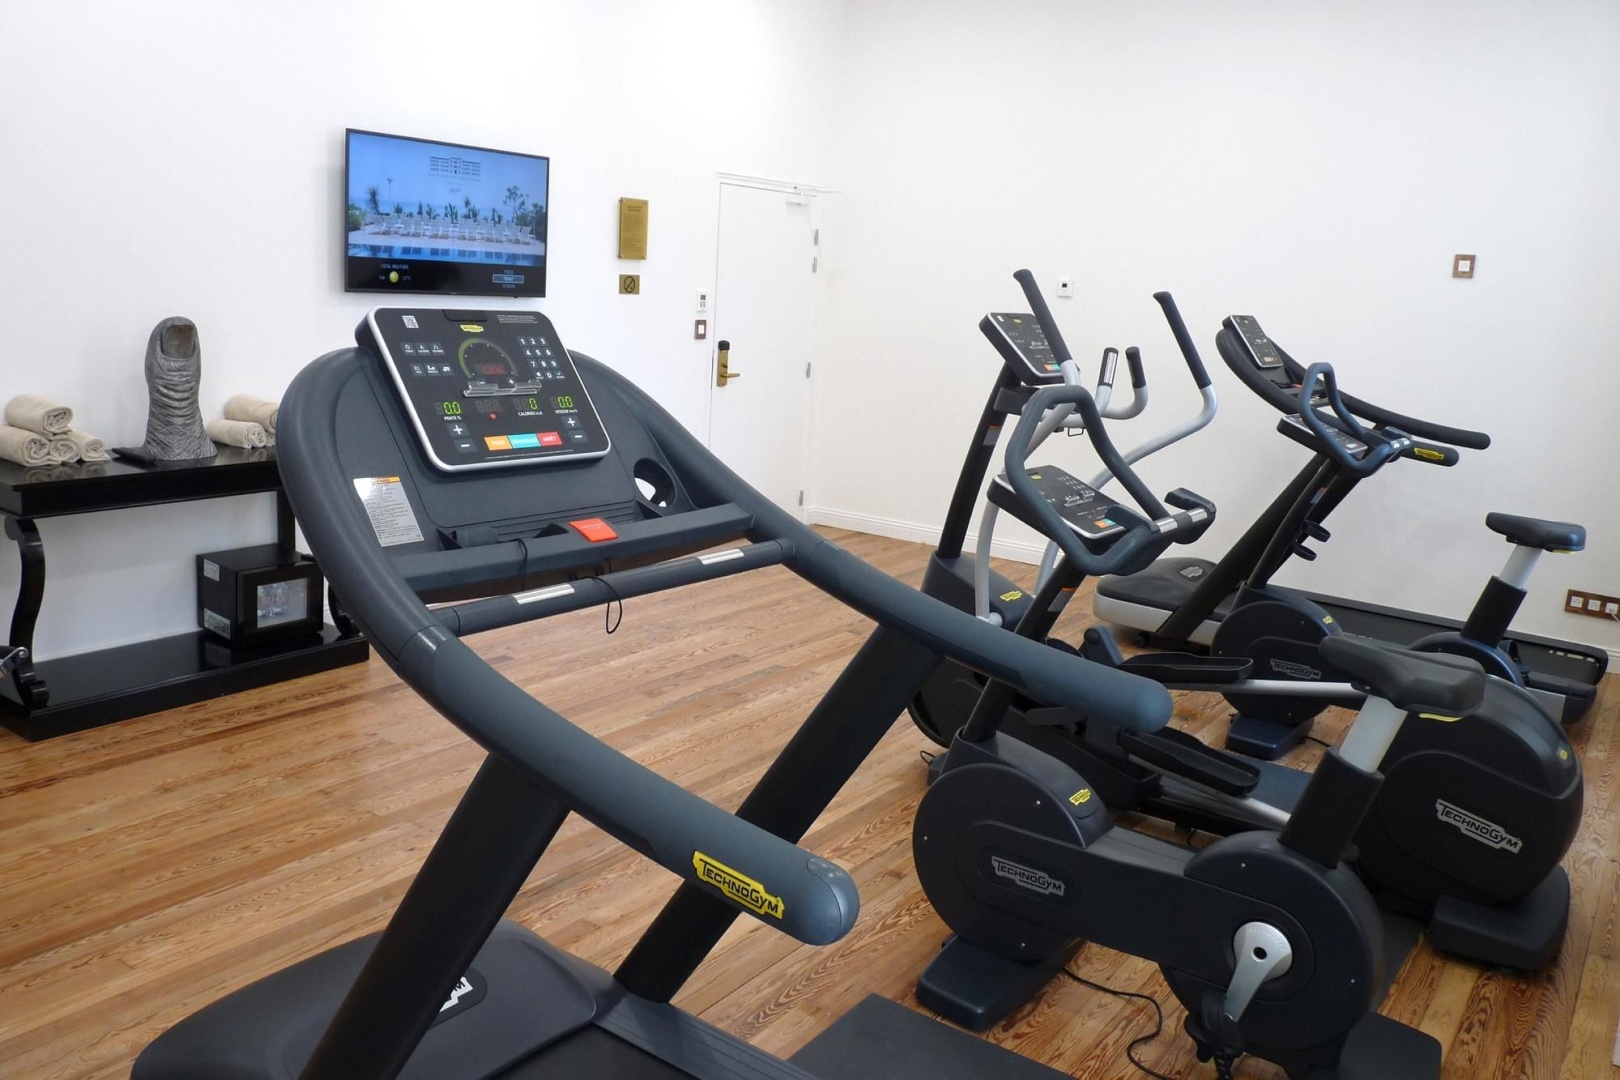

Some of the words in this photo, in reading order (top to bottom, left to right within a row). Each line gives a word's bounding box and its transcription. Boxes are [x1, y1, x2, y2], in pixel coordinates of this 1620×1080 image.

[529, 398, 538, 410] 0
[1437, 801, 1519, 849] TECHNOGYM
[698, 857, 779, 914] TECHNOGYM
[993, 858, 1062, 892] TECHNOGYM
